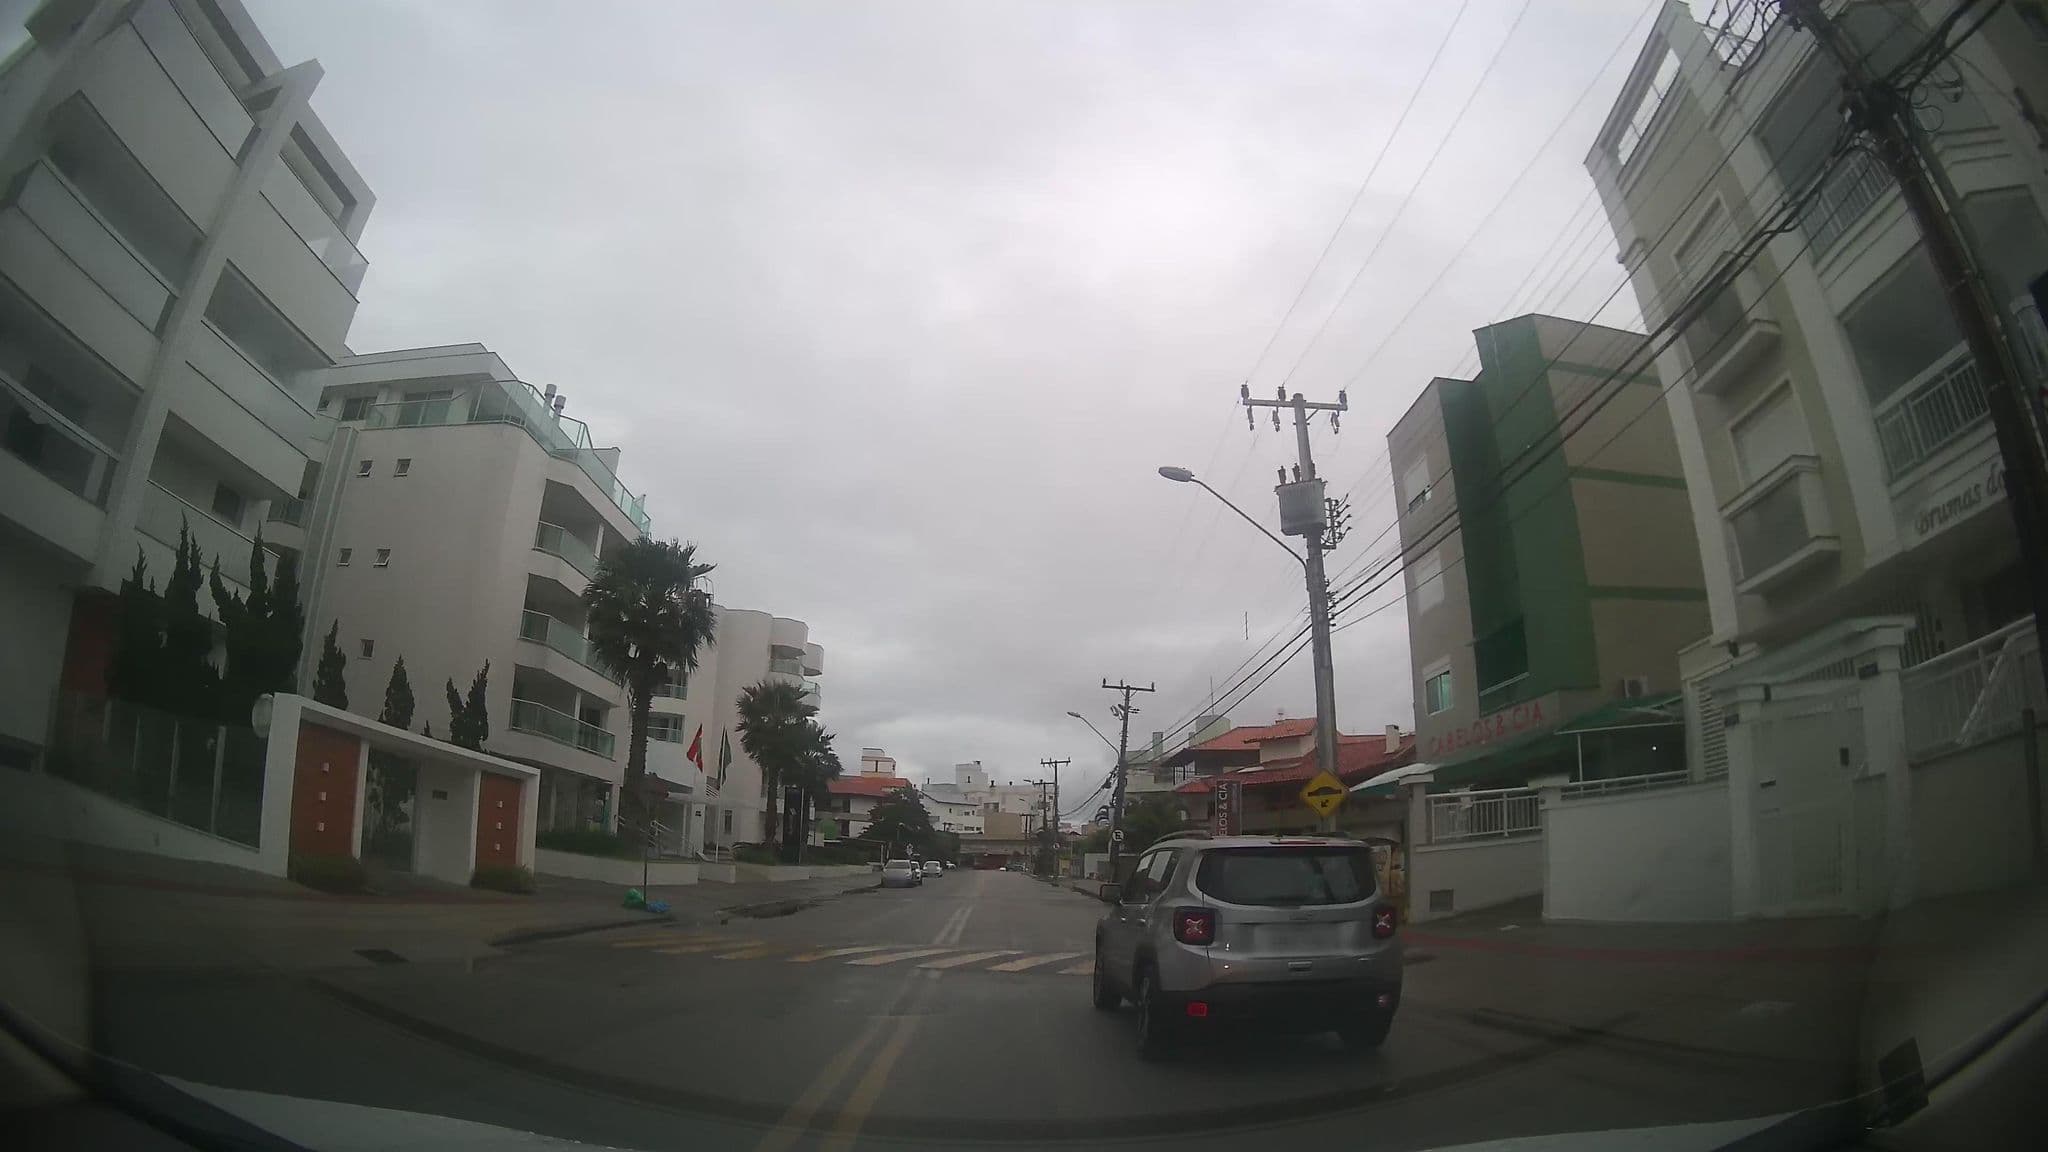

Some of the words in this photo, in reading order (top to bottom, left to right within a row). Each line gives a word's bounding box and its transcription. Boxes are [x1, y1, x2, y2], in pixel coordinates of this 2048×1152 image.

[1430, 718, 1492, 757] CABELOS
[1512, 699, 1543, 731] CIA
[1218, 782, 1228, 800] CIA
